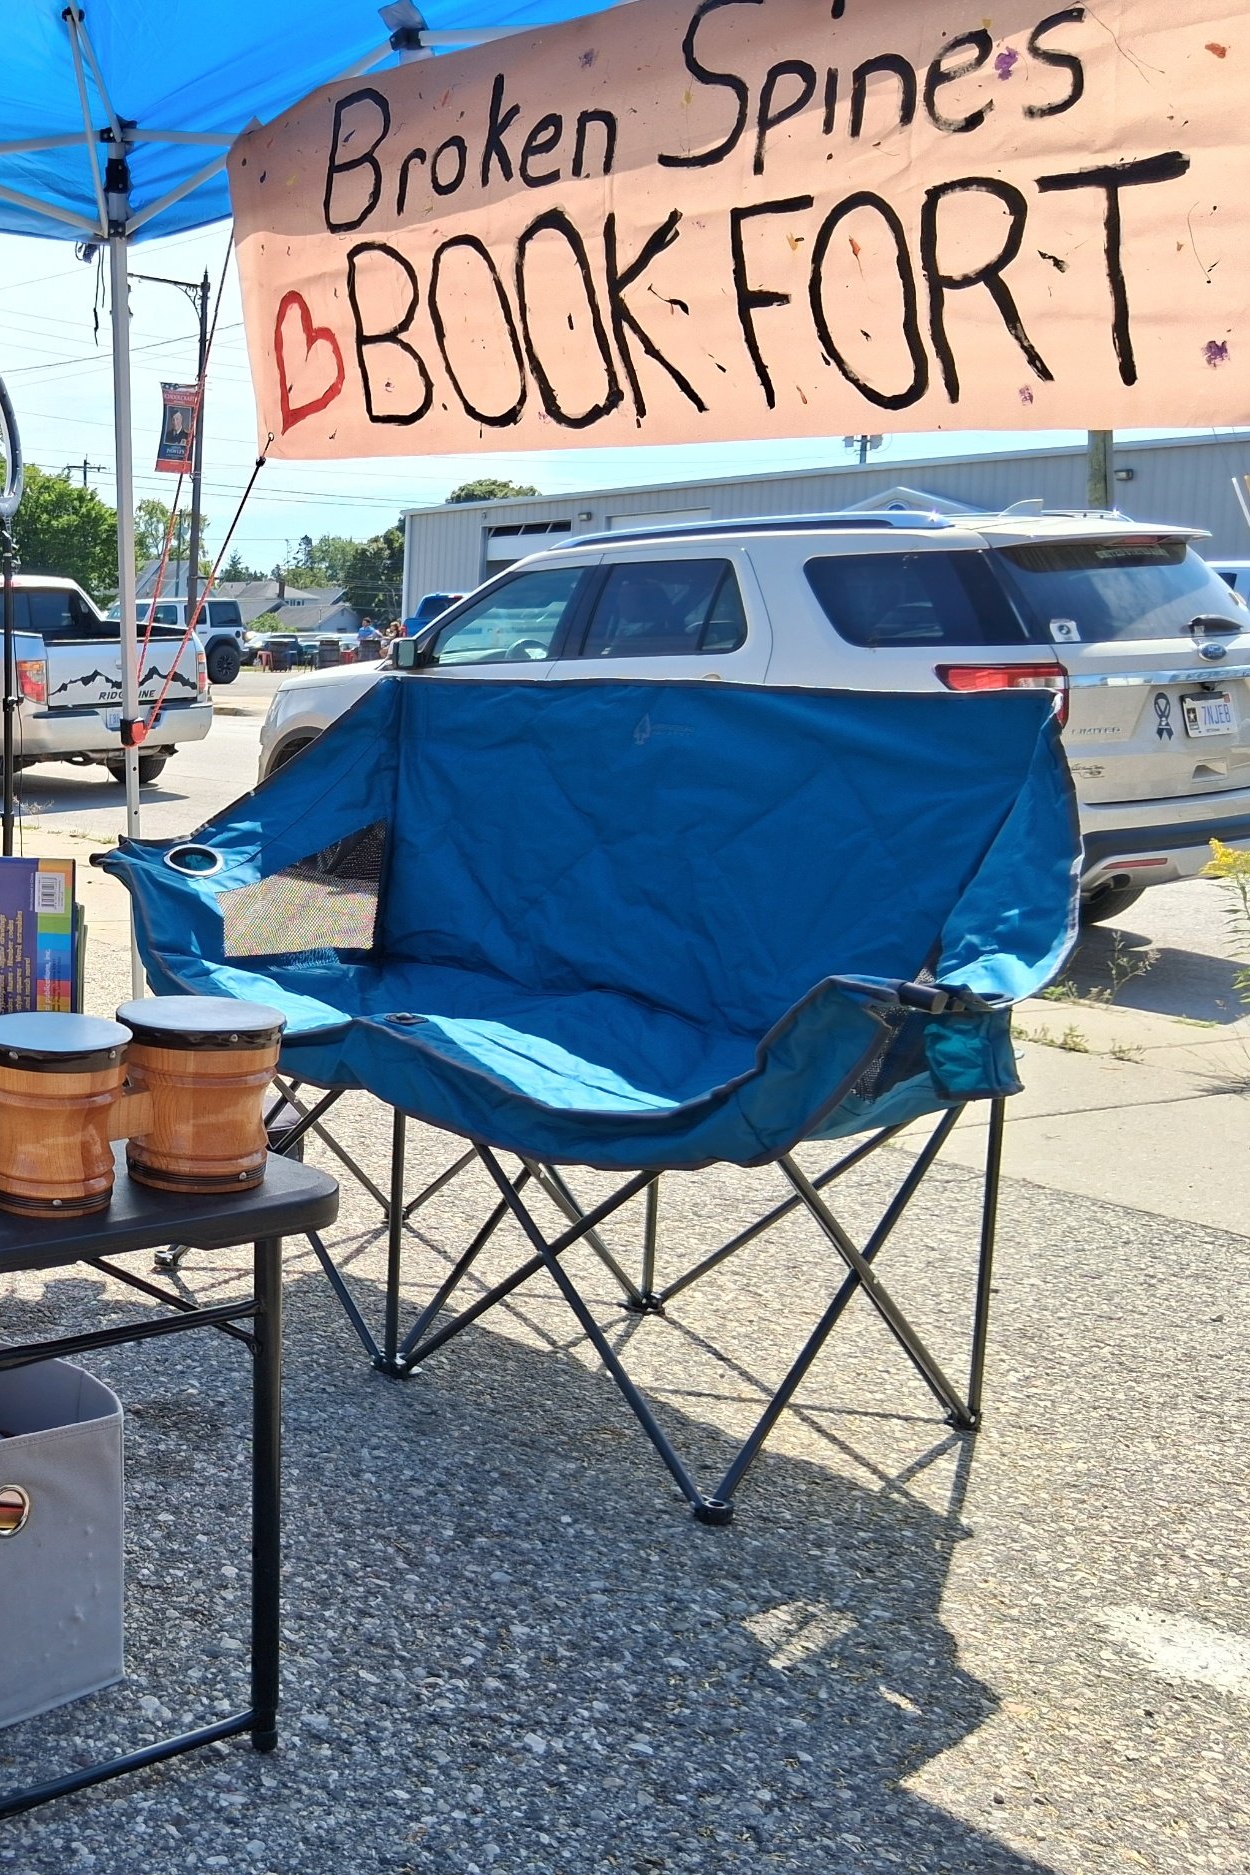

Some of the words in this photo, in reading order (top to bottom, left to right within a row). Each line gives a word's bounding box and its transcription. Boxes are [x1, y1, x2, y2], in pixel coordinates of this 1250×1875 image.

[324, 73, 617, 234] Broken
[657, 0, 1085, 175] Spines
[347, 207, 709, 430] BOOK
[730, 151, 1191, 411] FORT
[98, 689, 157, 701] RIDGINE
[1071, 727, 1121, 736] LIMITED
